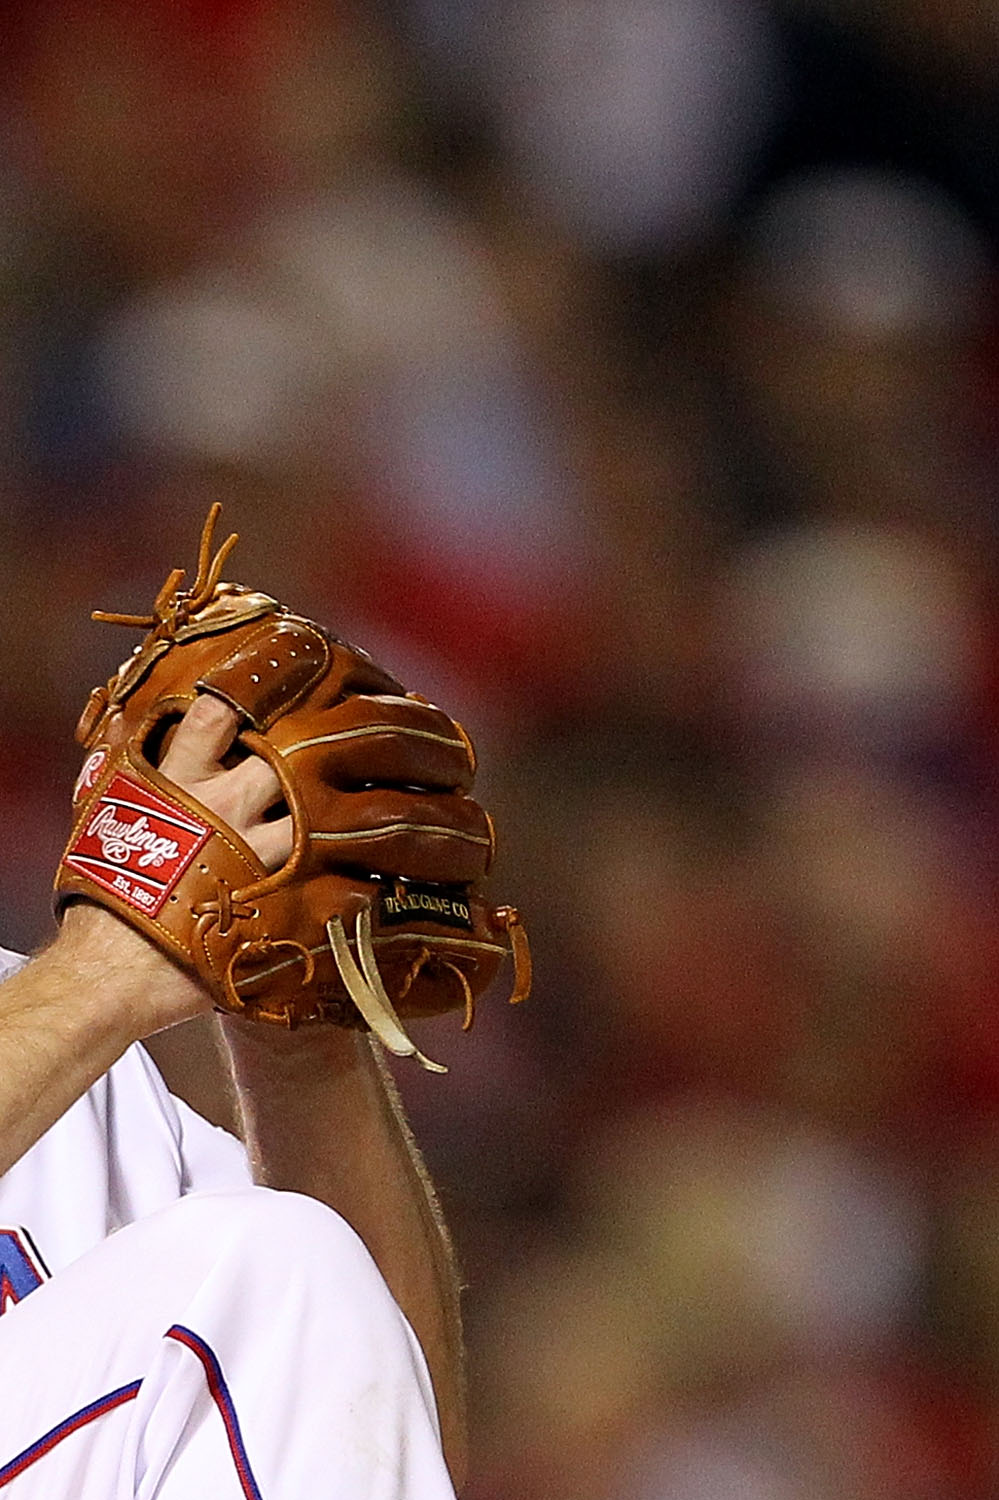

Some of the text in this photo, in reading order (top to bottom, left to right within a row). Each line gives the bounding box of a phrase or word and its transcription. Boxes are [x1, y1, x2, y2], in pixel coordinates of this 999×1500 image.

[87, 804, 180, 867] Rawlings
[112, 875, 156, 906] Est. 1887
